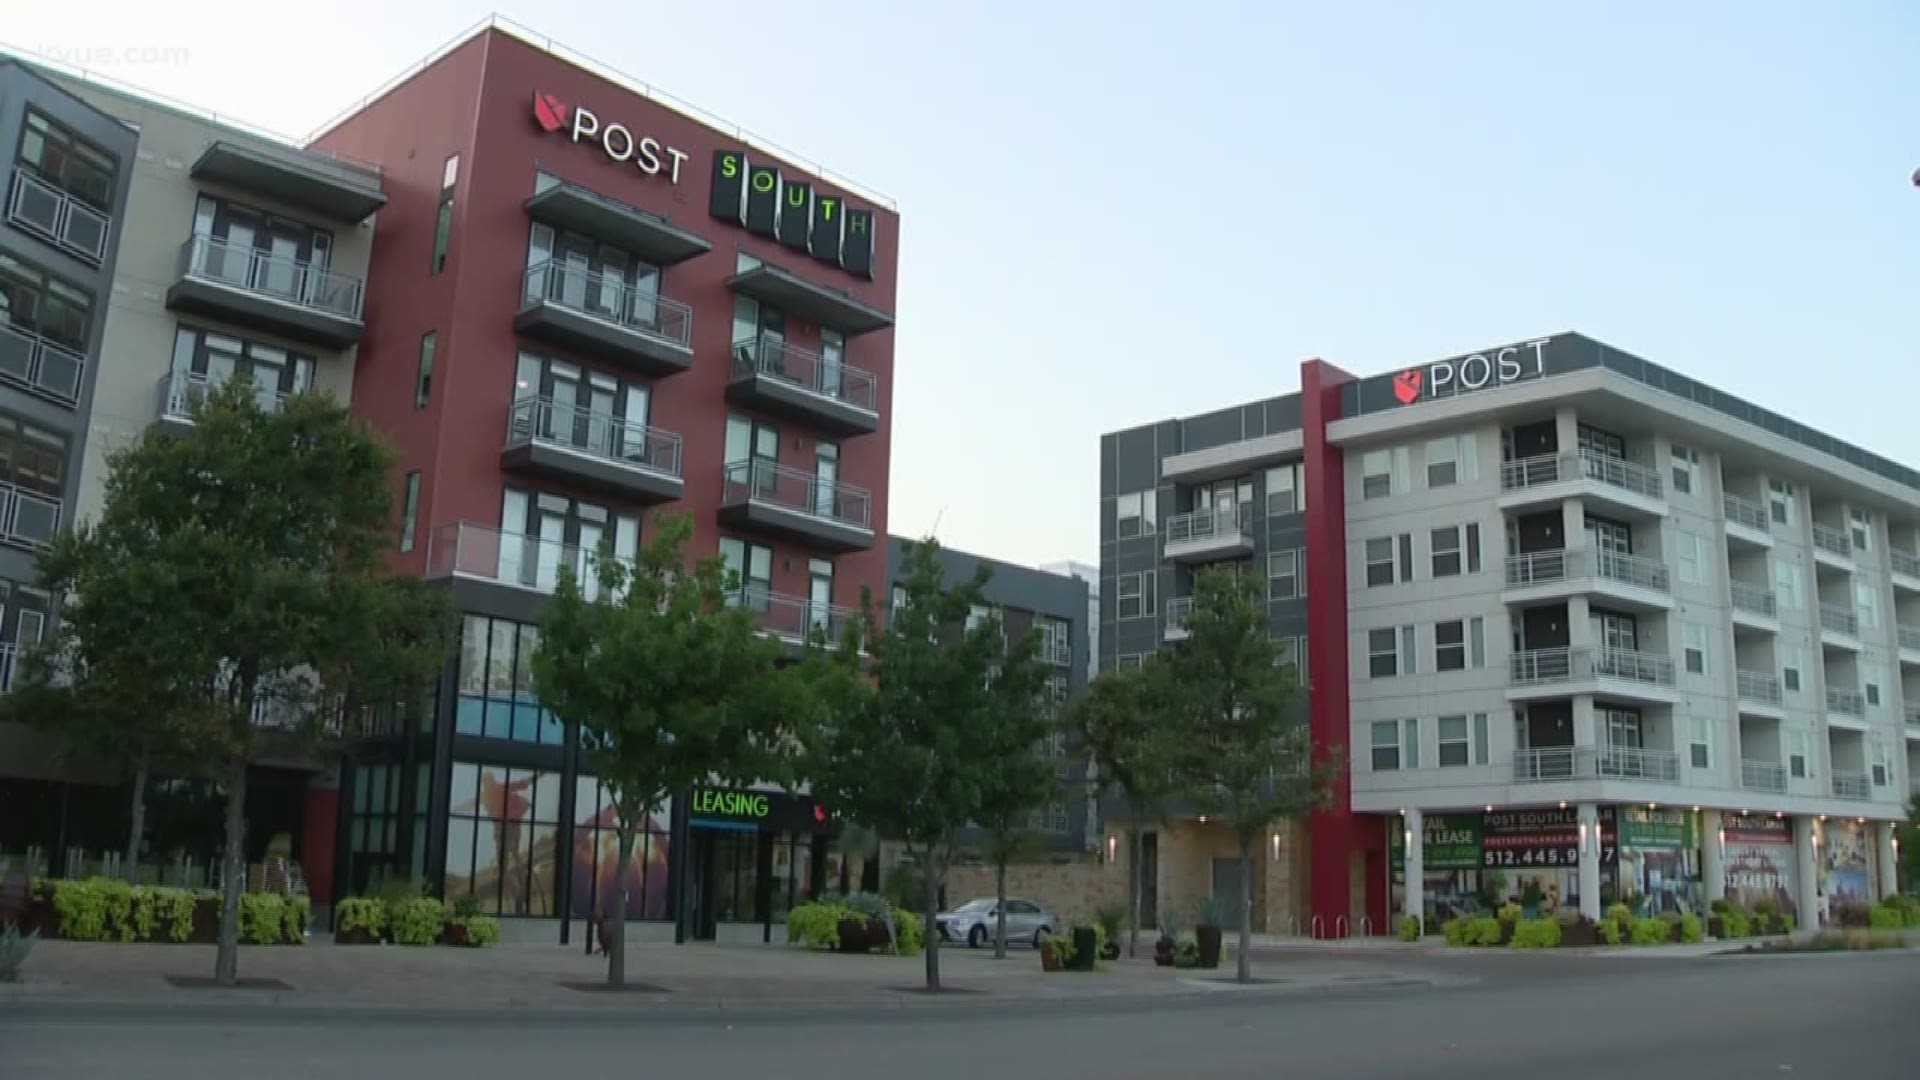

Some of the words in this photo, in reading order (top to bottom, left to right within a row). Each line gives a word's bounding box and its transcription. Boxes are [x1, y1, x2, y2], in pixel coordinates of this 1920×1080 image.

[571, 106, 689, 186] POST
[722, 155, 867, 235] SOUTH
[1430, 338, 1550, 397] POST
[693, 789, 769, 817] LEASING
[1519, 811, 1563, 824] SOUTH
[1436, 829, 1473, 845] LEASE
[1485, 847, 1615, 865] 512.445.97
